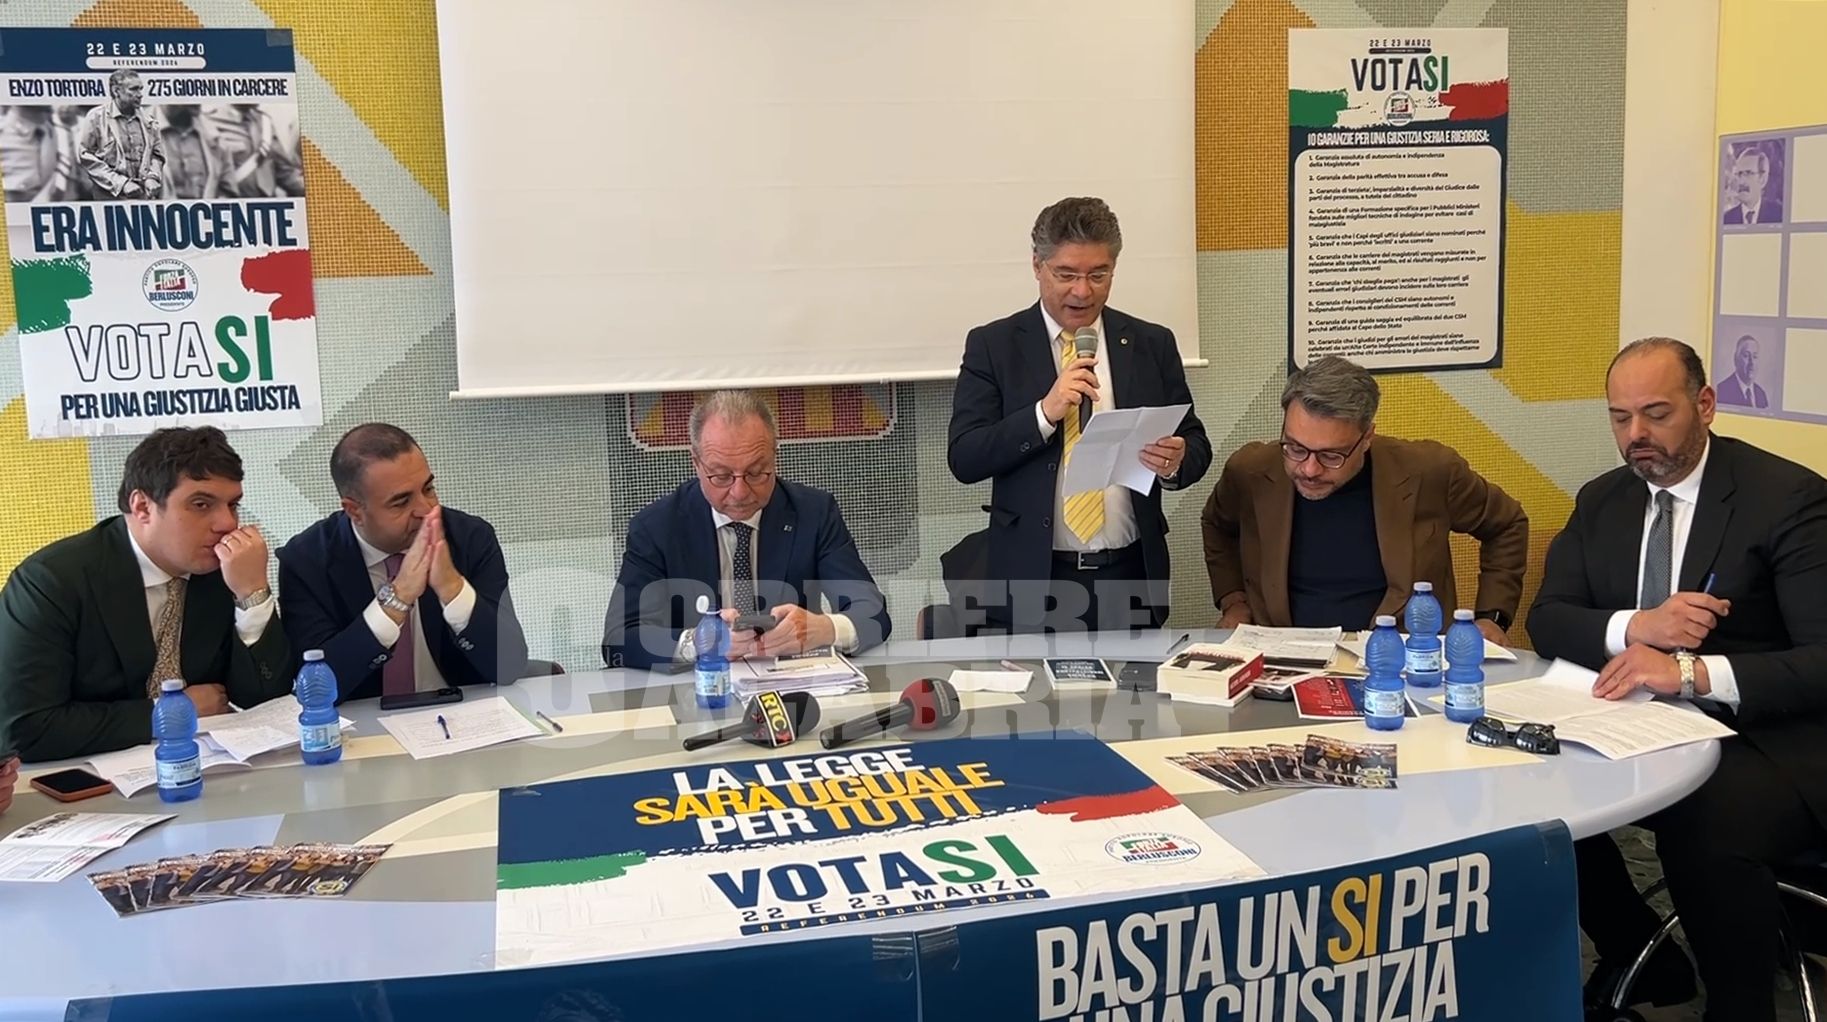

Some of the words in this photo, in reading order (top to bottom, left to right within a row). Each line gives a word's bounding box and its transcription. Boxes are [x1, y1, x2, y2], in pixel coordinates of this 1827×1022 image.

[86, 43, 105, 55] 22
[113, 43, 120, 55] E
[129, 43, 147, 55] 23
[155, 43, 205, 55] MARZO
[1369, 39, 1379, 47] 22
[1383, 39, 1387, 47] E
[1391, 39, 1401, 47] 23
[9, 79, 44, 97] ENZO
[45, 79, 106, 97] TORTORA
[147, 78, 172, 97] 275
[173, 78, 217, 97] GIORNI
[218, 78, 232, 96] IN
[233, 78, 289, 97] CARCERE
[1317, 132, 1352, 145] GARANZIE
[1354, 132, 1369, 145] PER
[1370, 132, 1385, 144] UNA
[1387, 132, 1421, 144] GIUSTIZIA
[1423, 131, 1444, 143] SERIA
[1445, 131, 1449, 143] E
[31, 205, 104, 253] ERA
[105, 202, 298, 252] INNOCENTE
[149, 291, 193, 301] BERLUSCONI
[61, 393, 99, 420] PER
[101, 391, 143, 418] UNA
[143, 388, 234, 417] GIUSTIZIA
[235, 384, 301, 412] GIUSTA
[761, 693, 787, 732] RTC
[673, 768, 745, 796] LA
[754, 748, 925, 787] LEGGE
[633, 782, 787, 825] SARÀ
[786, 762, 1006, 807] UGUALE
[697, 808, 818, 845] PER
[813, 790, 982, 830] TUTTI
[1122, 848, 1198, 863] BERLUSCONI
[741, 907, 785, 923] 22
[809, 901, 826, 915] E
[848, 894, 891, 909] 23
[911, 877, 1036, 902] MARZO
[760, 904, 946, 932] REFERENDUM
[1036, 903, 1226, 1021] BASTA
[1236, 885, 1321, 981] UN
[1327, 873, 1382, 963] SI
[1389, 852, 1490, 952] PER
